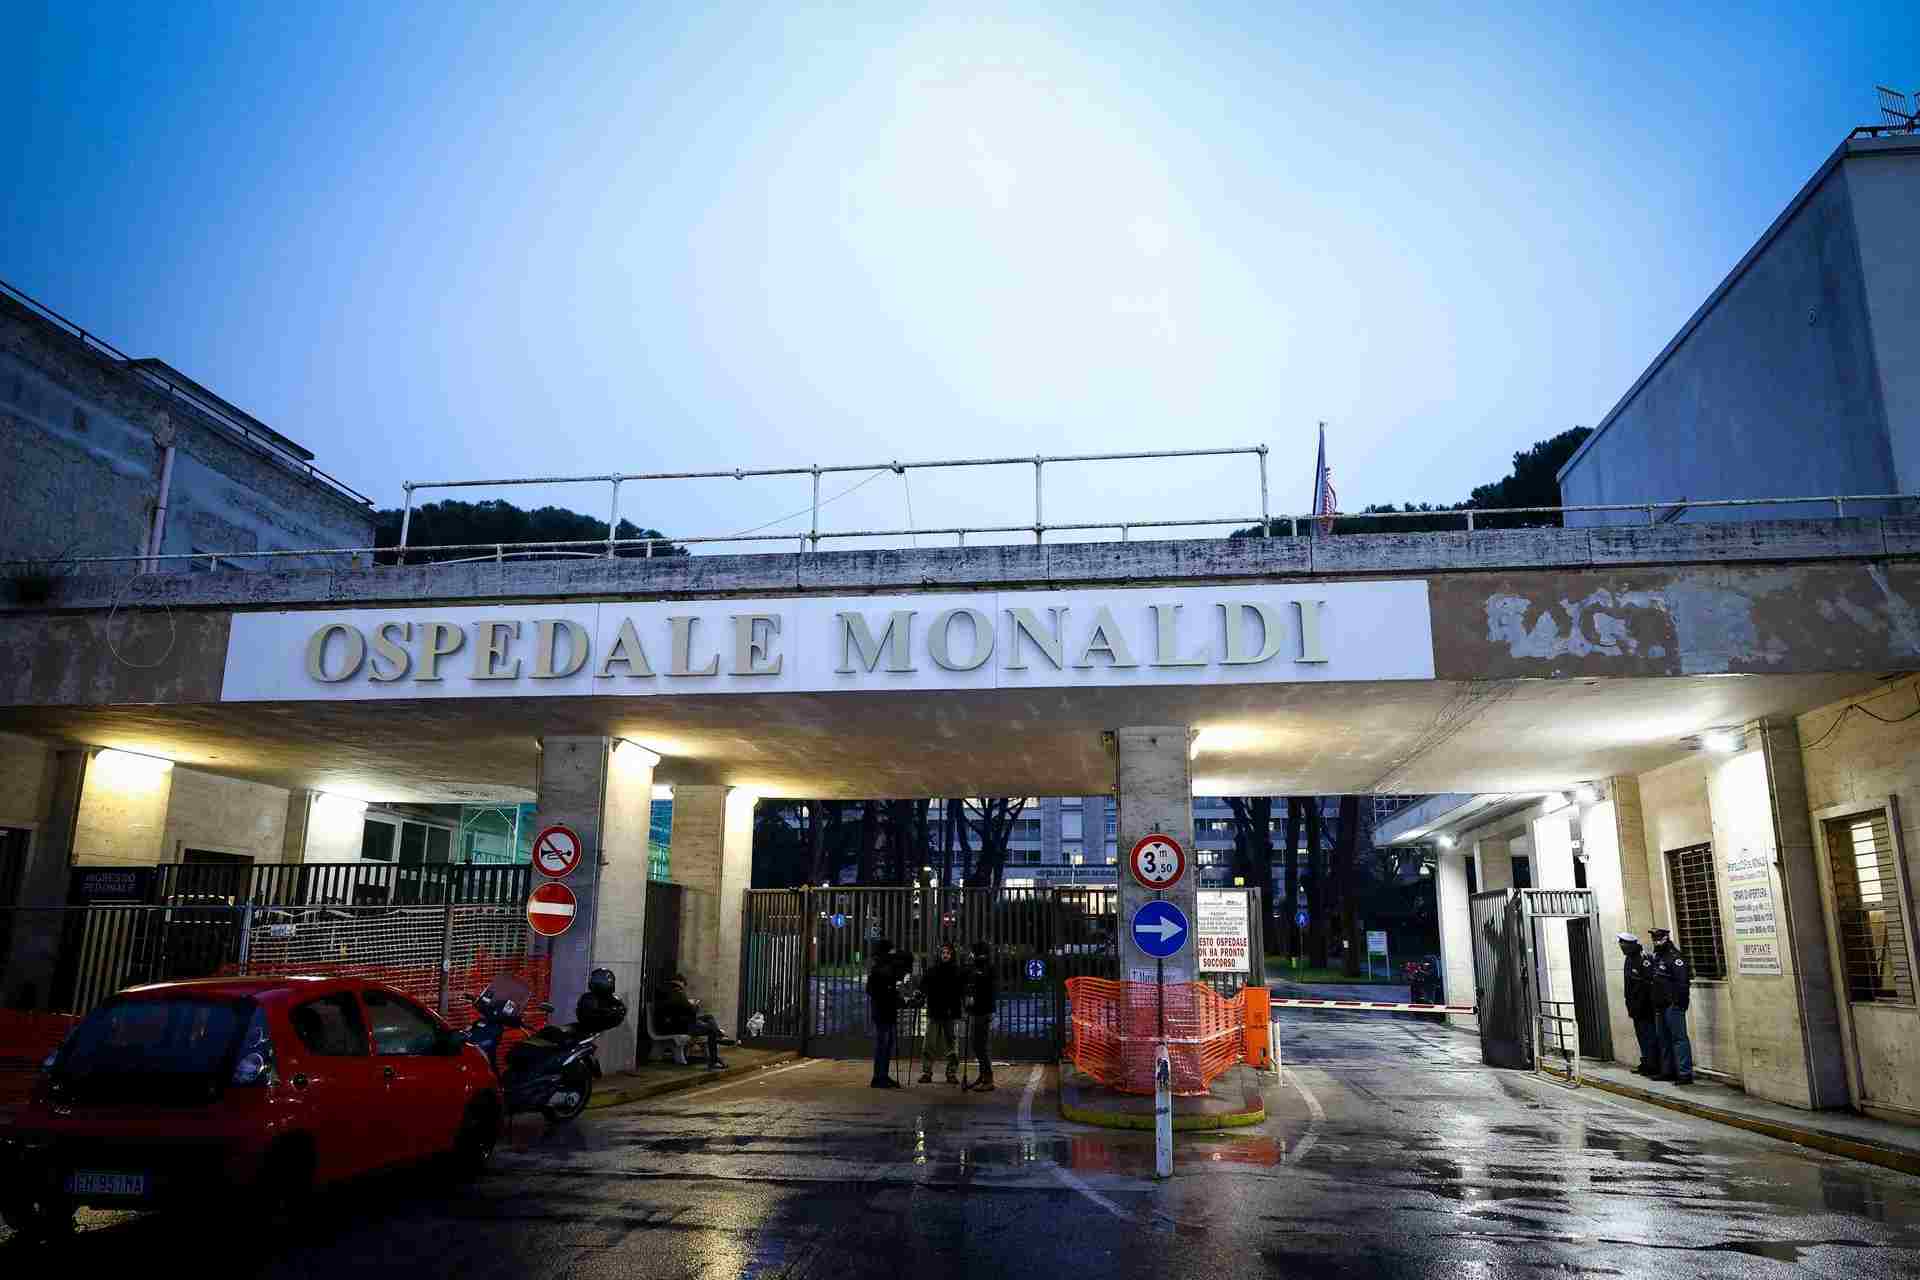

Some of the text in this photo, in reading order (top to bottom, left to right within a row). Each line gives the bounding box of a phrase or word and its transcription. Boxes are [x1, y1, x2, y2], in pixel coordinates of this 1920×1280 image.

[305, 599, 1329, 683] OSPEDALE MONALDI
[1199, 936, 1247, 947] ESTO OSPEDALE
[1209, 947, 1218, 957] HA
[1219, 948, 1245, 957] PRONTO
[1203, 958, 1236, 968] SOCCORSO
